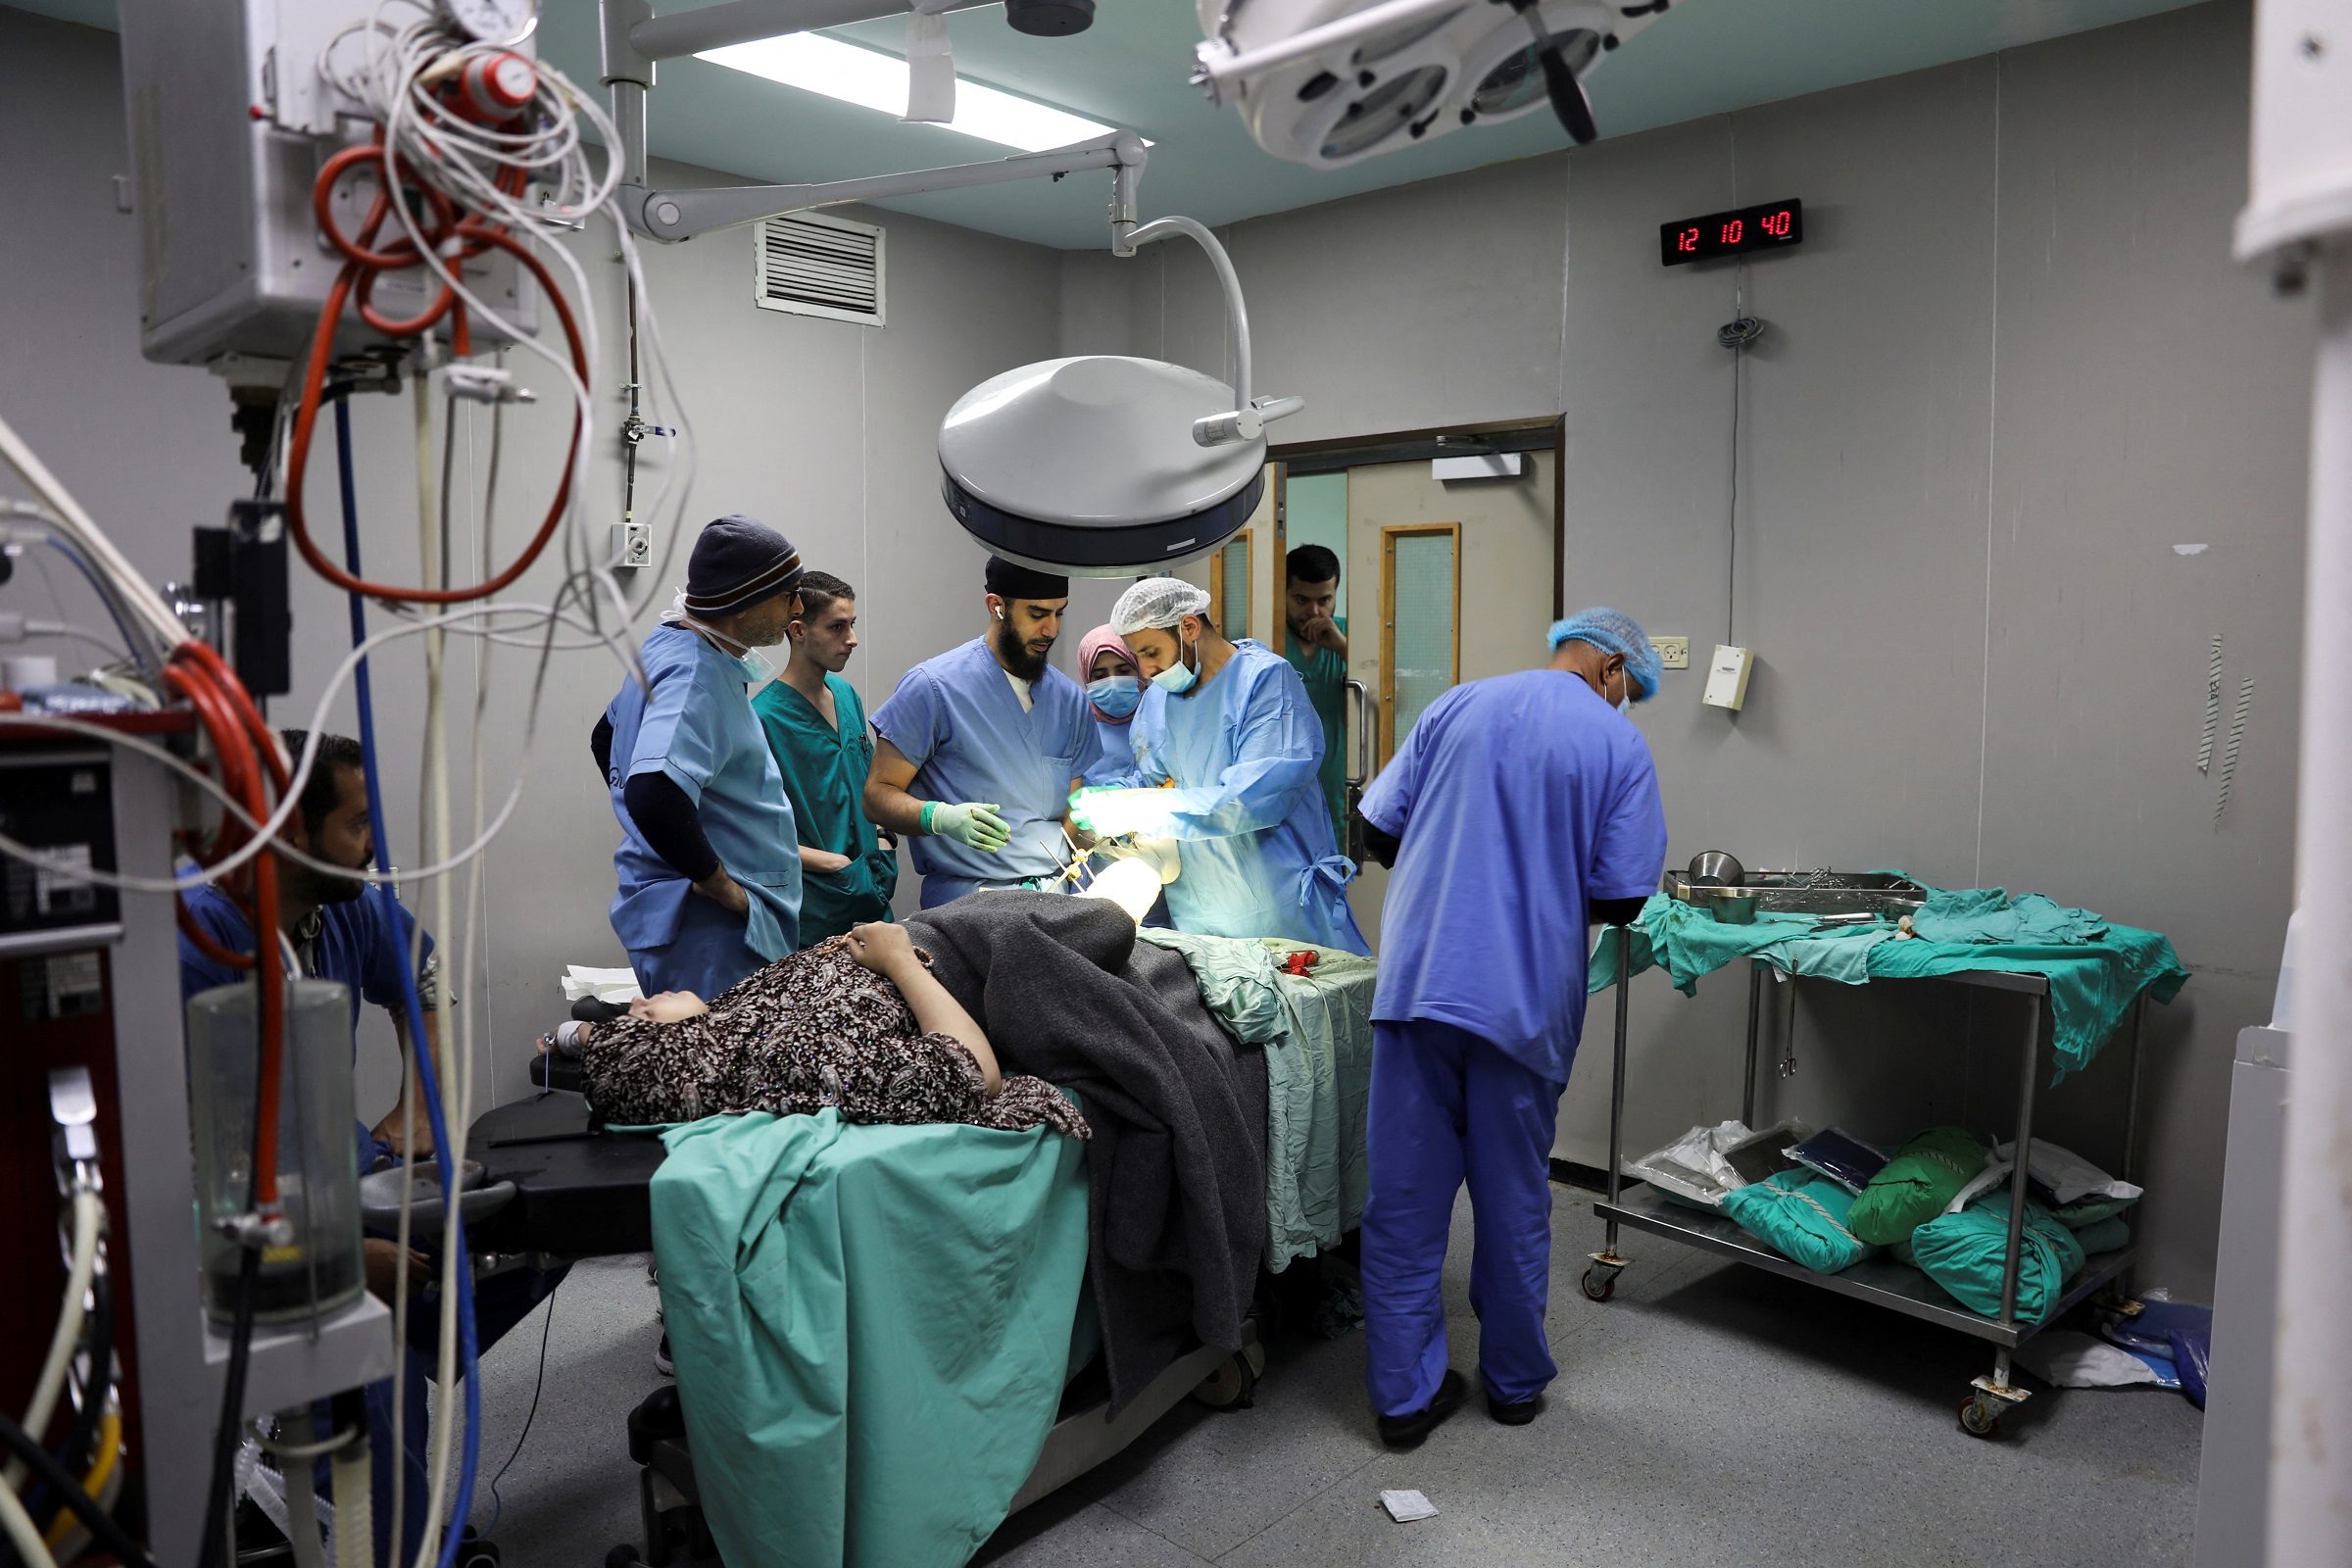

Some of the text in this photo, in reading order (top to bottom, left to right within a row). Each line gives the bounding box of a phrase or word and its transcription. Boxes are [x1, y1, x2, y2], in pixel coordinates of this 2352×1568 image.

[1678, 211, 1790, 251] 12 10 40
